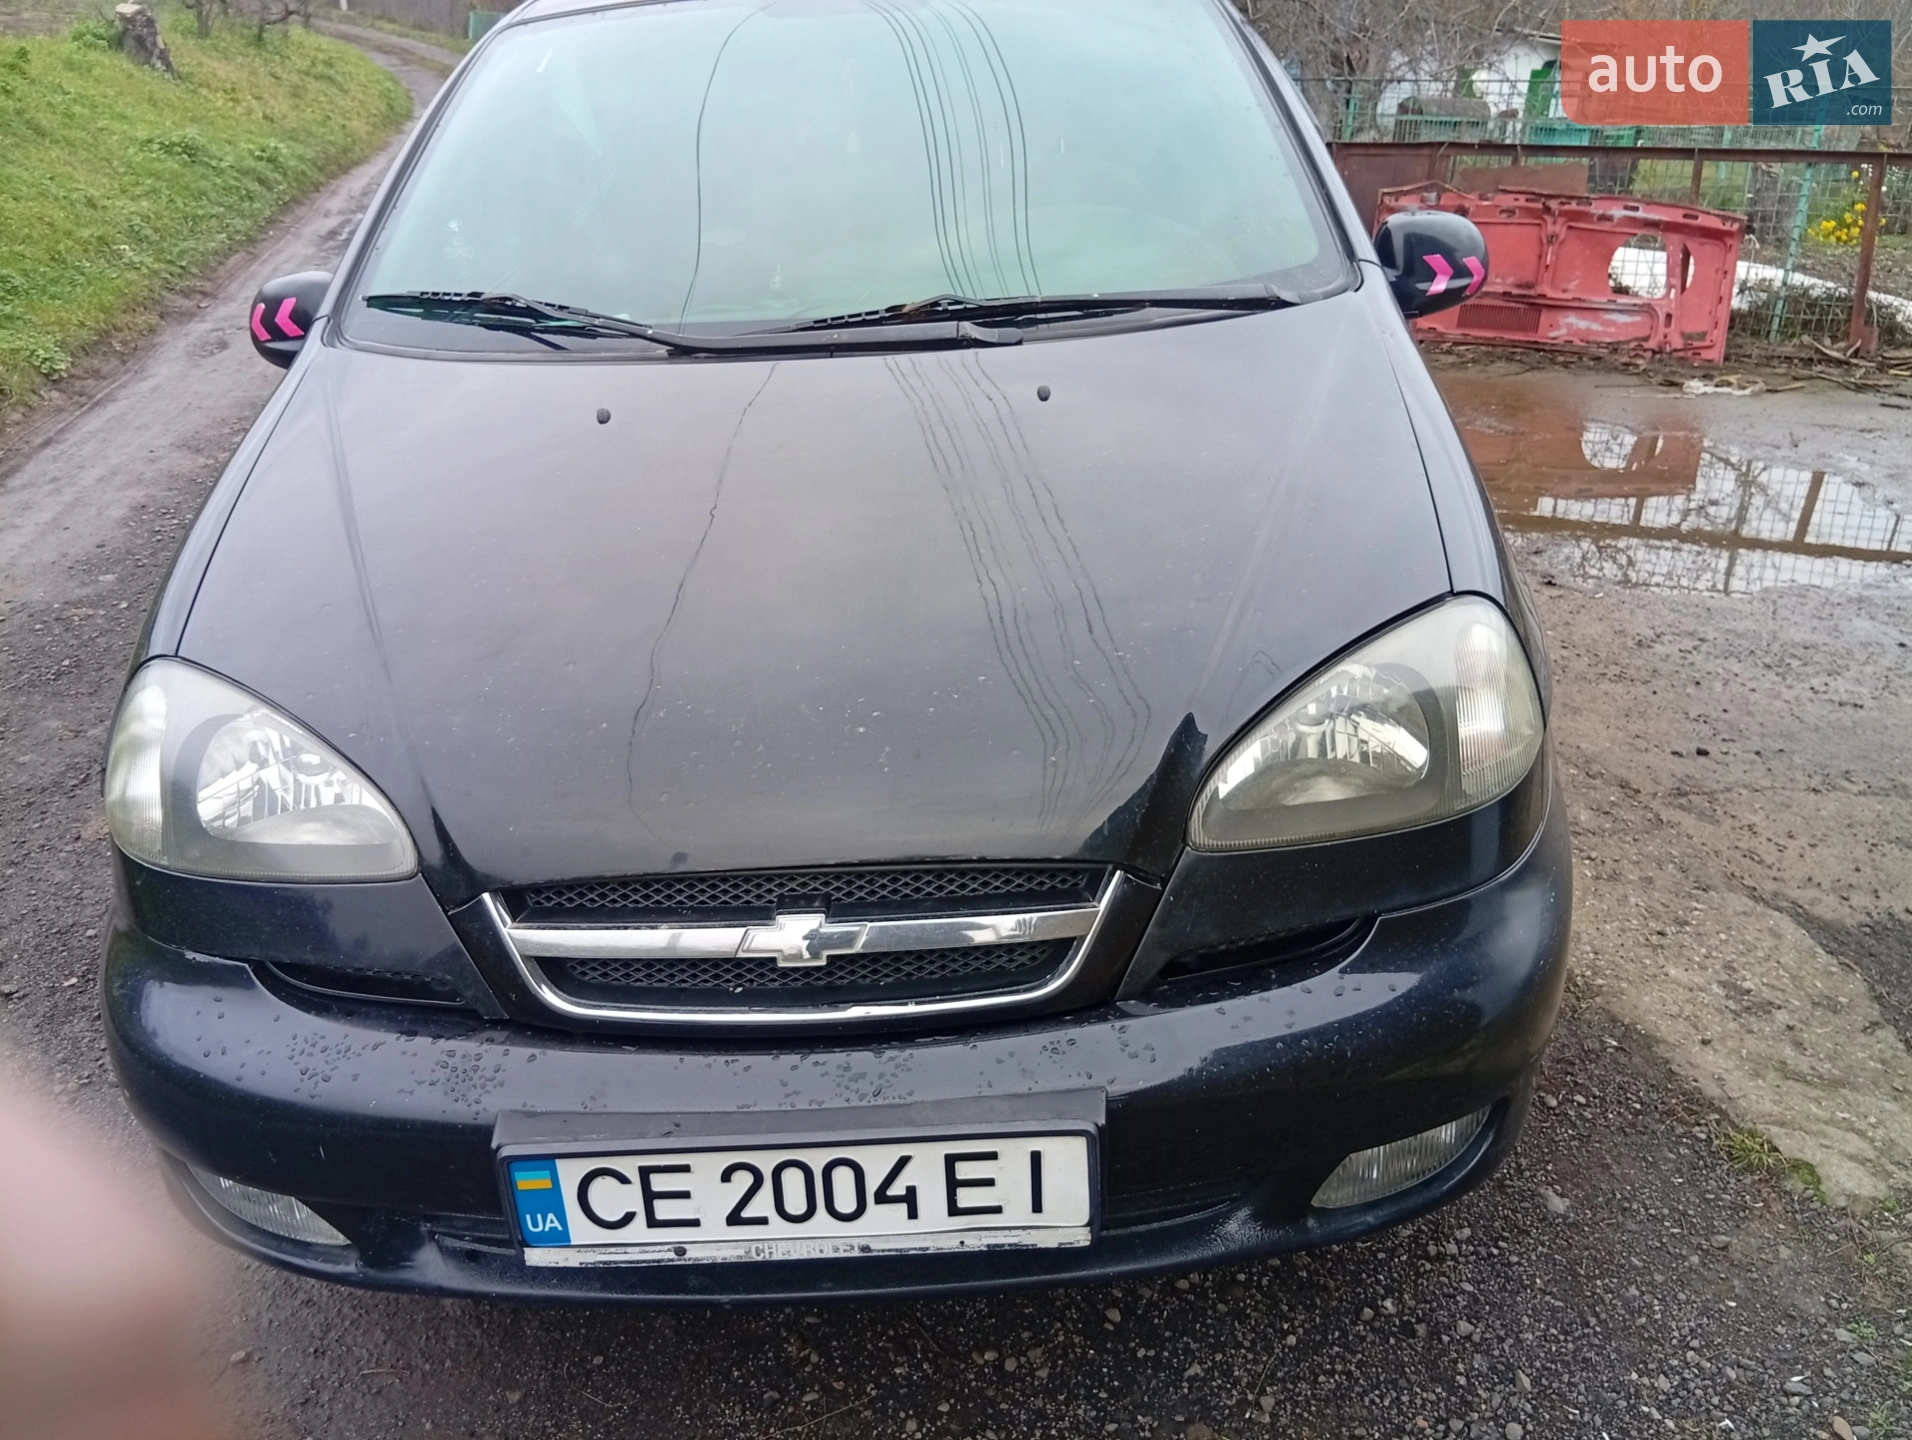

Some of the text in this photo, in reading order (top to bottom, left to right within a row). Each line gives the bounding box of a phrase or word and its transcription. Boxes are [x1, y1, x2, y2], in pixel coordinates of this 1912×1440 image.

[576, 1163, 701, 1230] CE
[720, 1155, 921, 1227] 2004
[526, 1212, 564, 1234] UA
